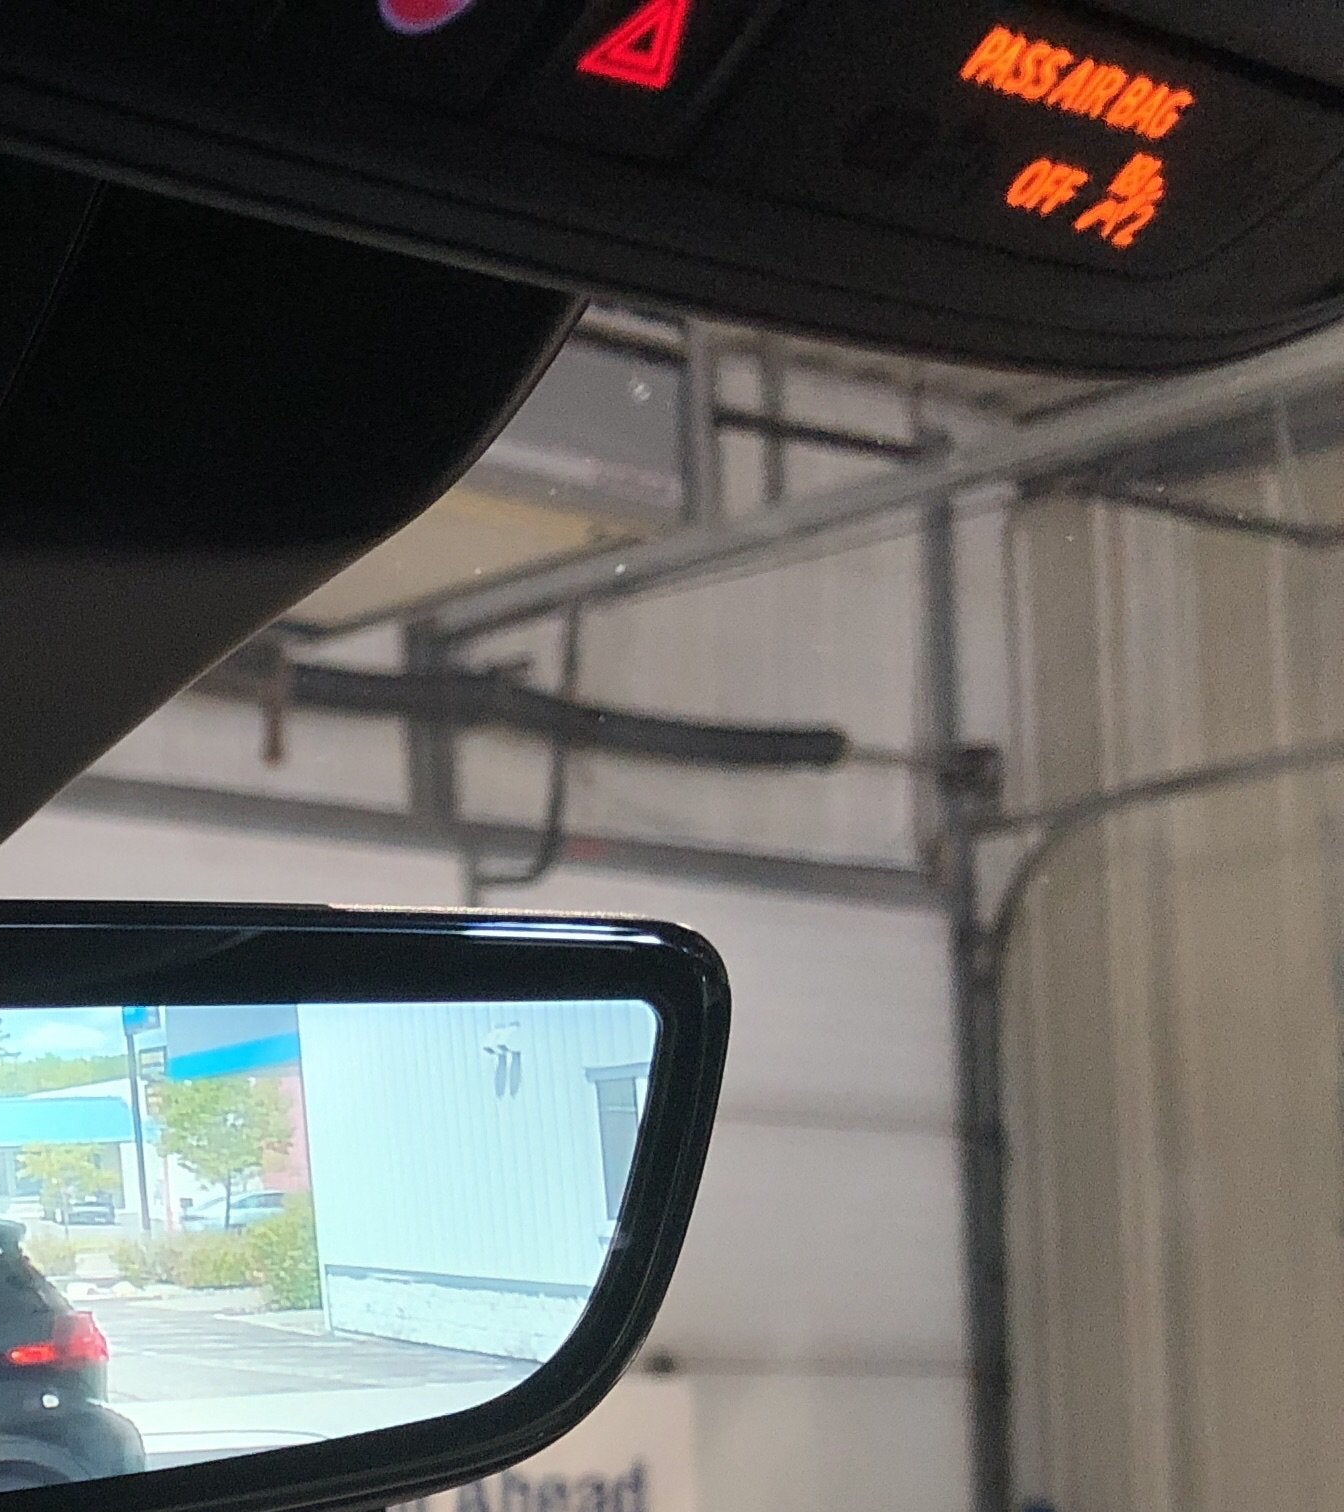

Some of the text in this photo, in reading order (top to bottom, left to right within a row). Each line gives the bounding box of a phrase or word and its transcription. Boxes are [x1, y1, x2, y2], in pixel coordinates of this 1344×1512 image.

[960, 24, 1195, 140] PASS AIR BAG
[1005, 156, 1090, 216] OFF
